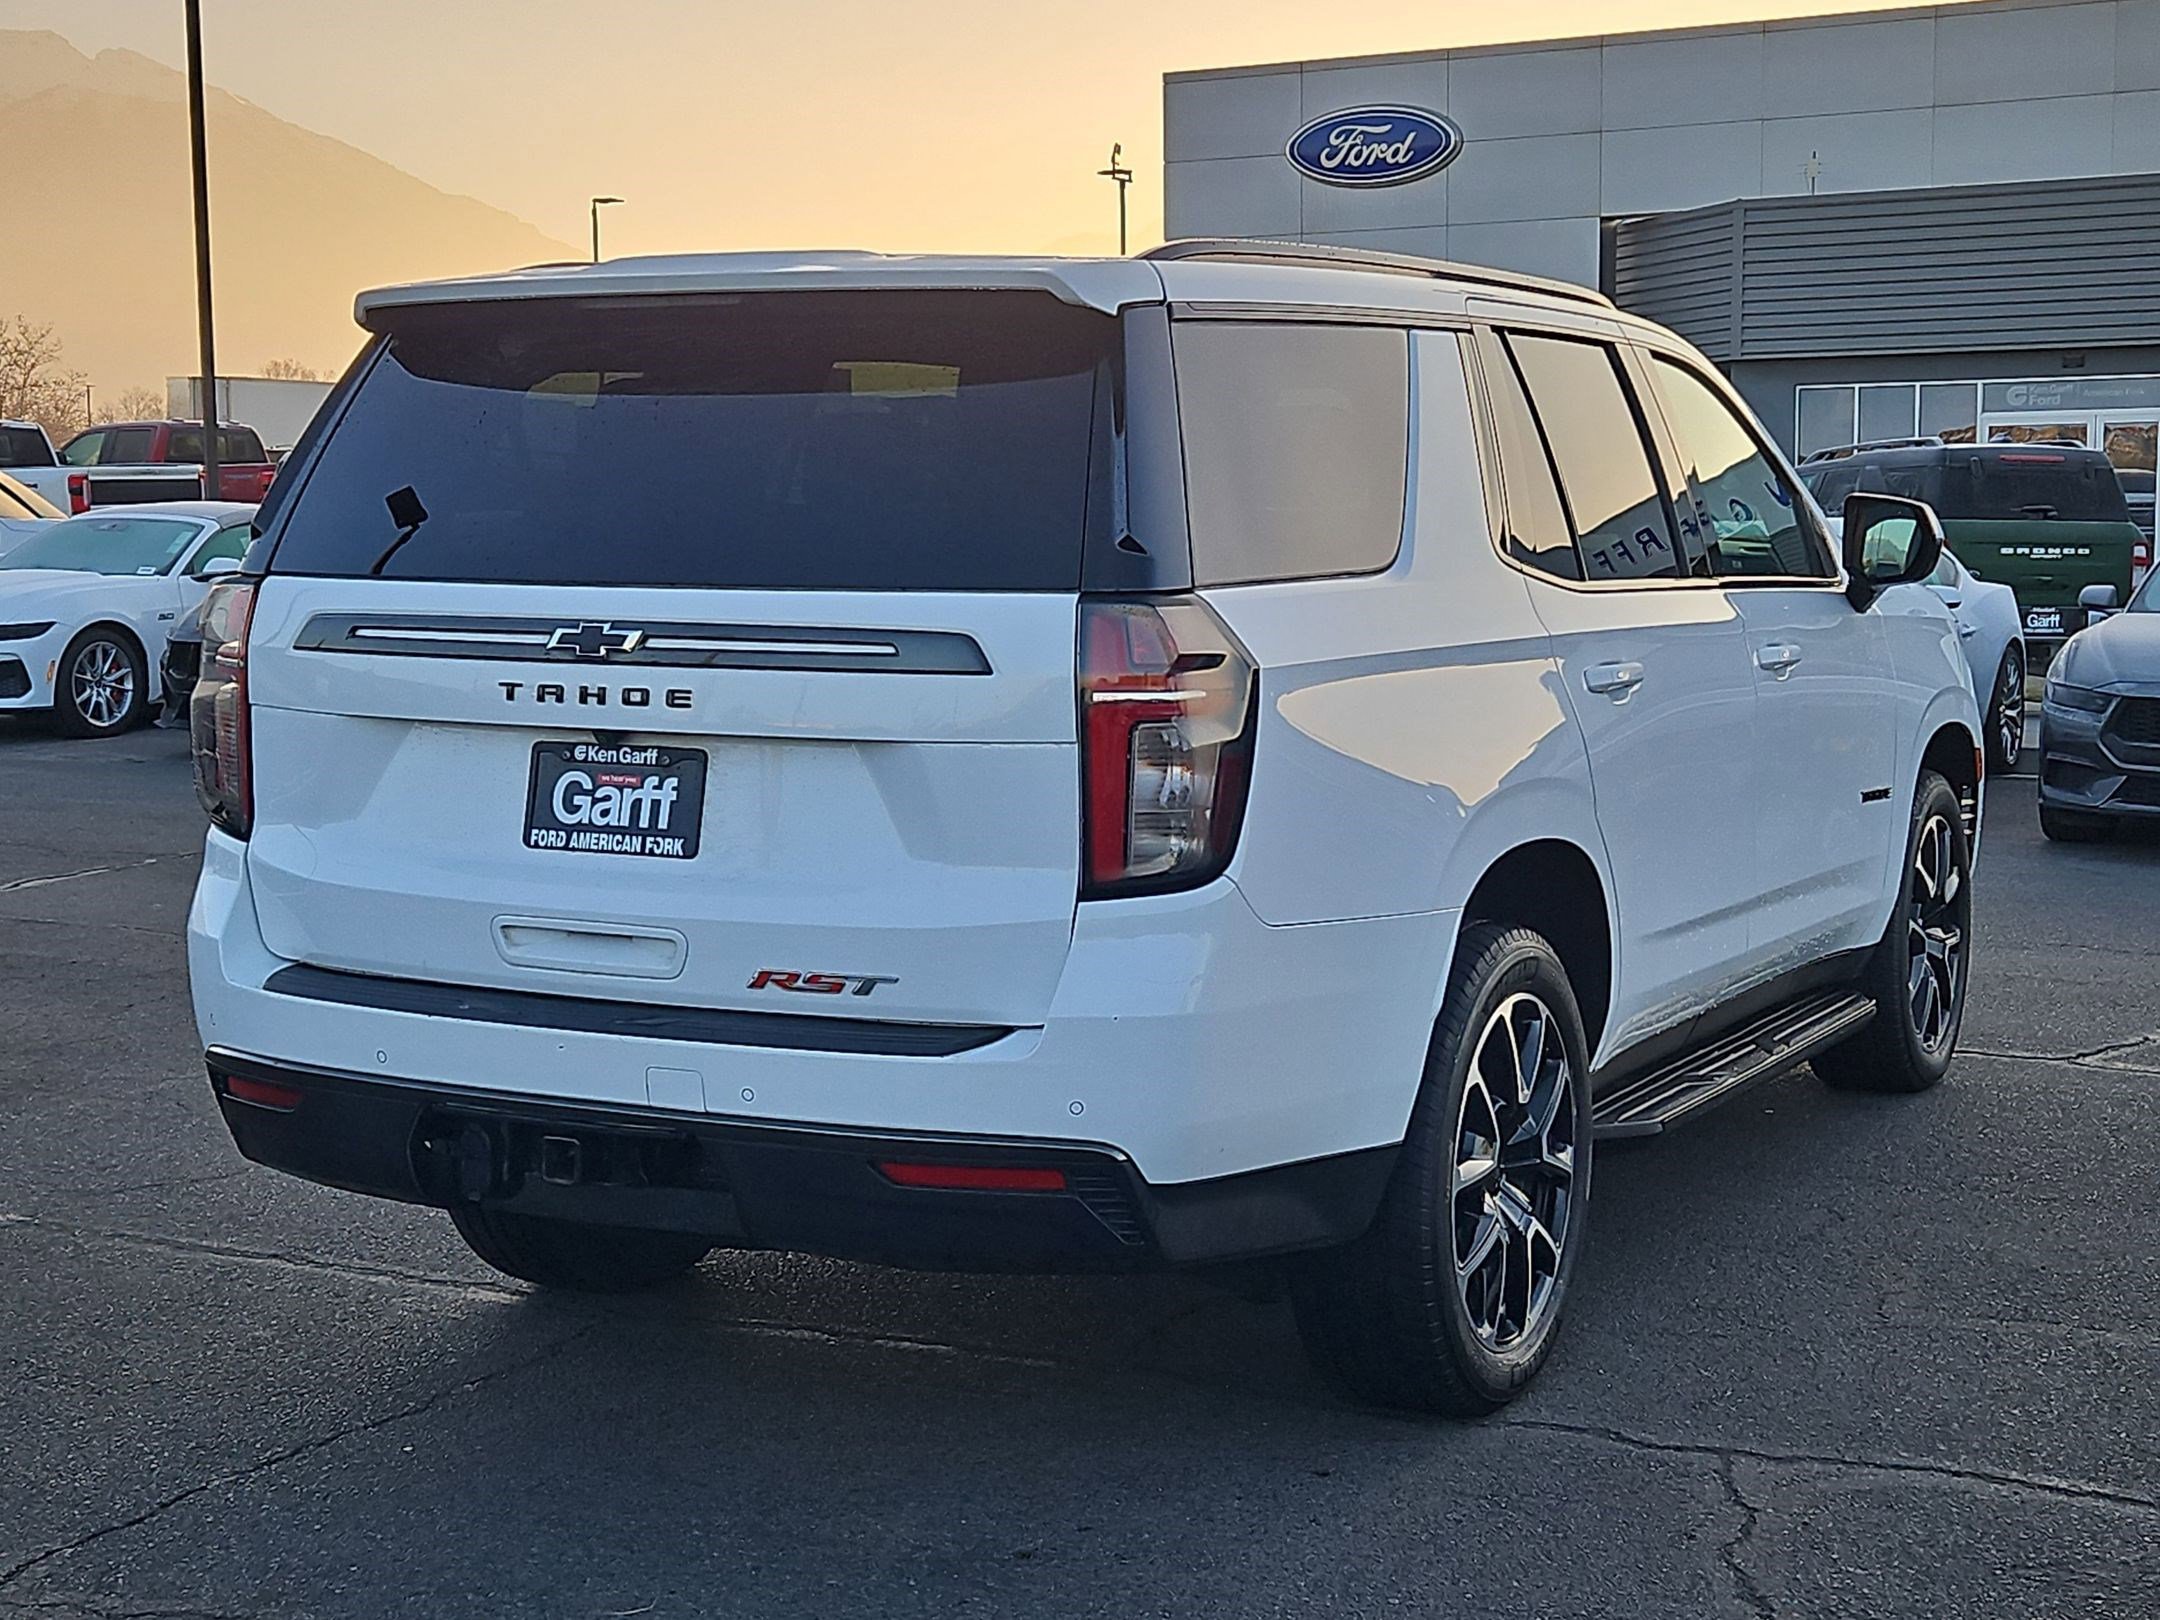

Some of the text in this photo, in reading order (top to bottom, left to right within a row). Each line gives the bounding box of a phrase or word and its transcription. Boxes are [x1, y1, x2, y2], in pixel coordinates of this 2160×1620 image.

[1319, 123, 1417, 169] Ford
[2029, 394, 2061, 406] Ford
[2027, 614, 2060, 628] Garff
[498, 682, 693, 709] TAHOE
[588, 745, 618, 763] Ken
[619, 746, 659, 766] Garff
[552, 770, 678, 830] Garff
[530, 828, 685, 857] FORD AMERICAN FORK
[746, 968, 899, 996] RST
